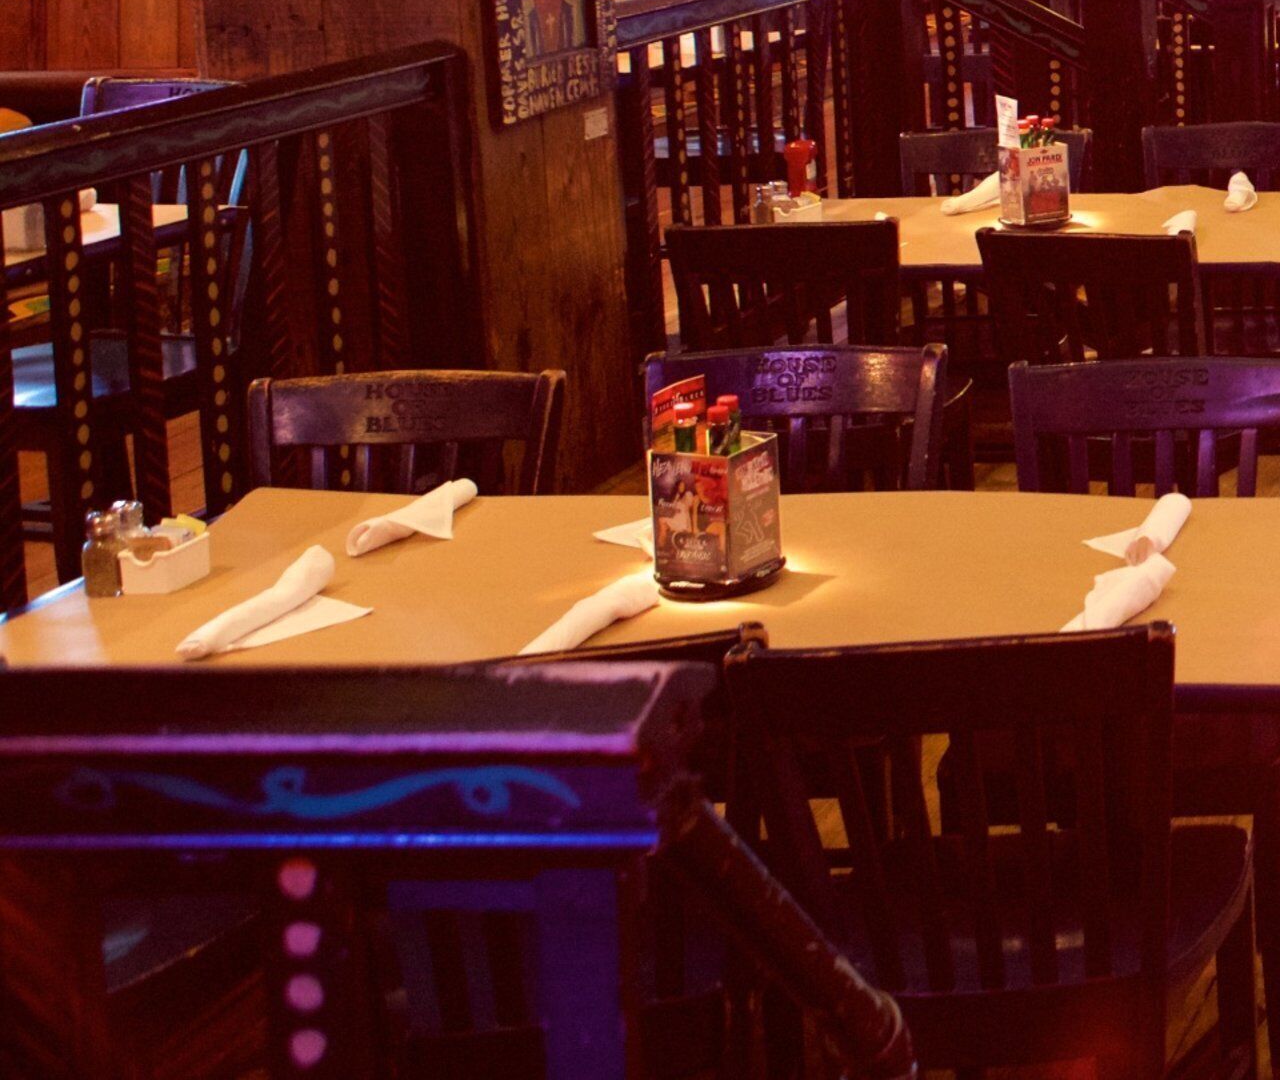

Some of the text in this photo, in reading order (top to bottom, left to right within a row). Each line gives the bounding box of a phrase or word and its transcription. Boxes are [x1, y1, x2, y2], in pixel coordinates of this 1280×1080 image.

[498, 33, 516, 124] FORMER
[755, 356, 836, 373] HOUSE
[778, 373, 804, 387] OF
[752, 386, 833, 402] BLUES
